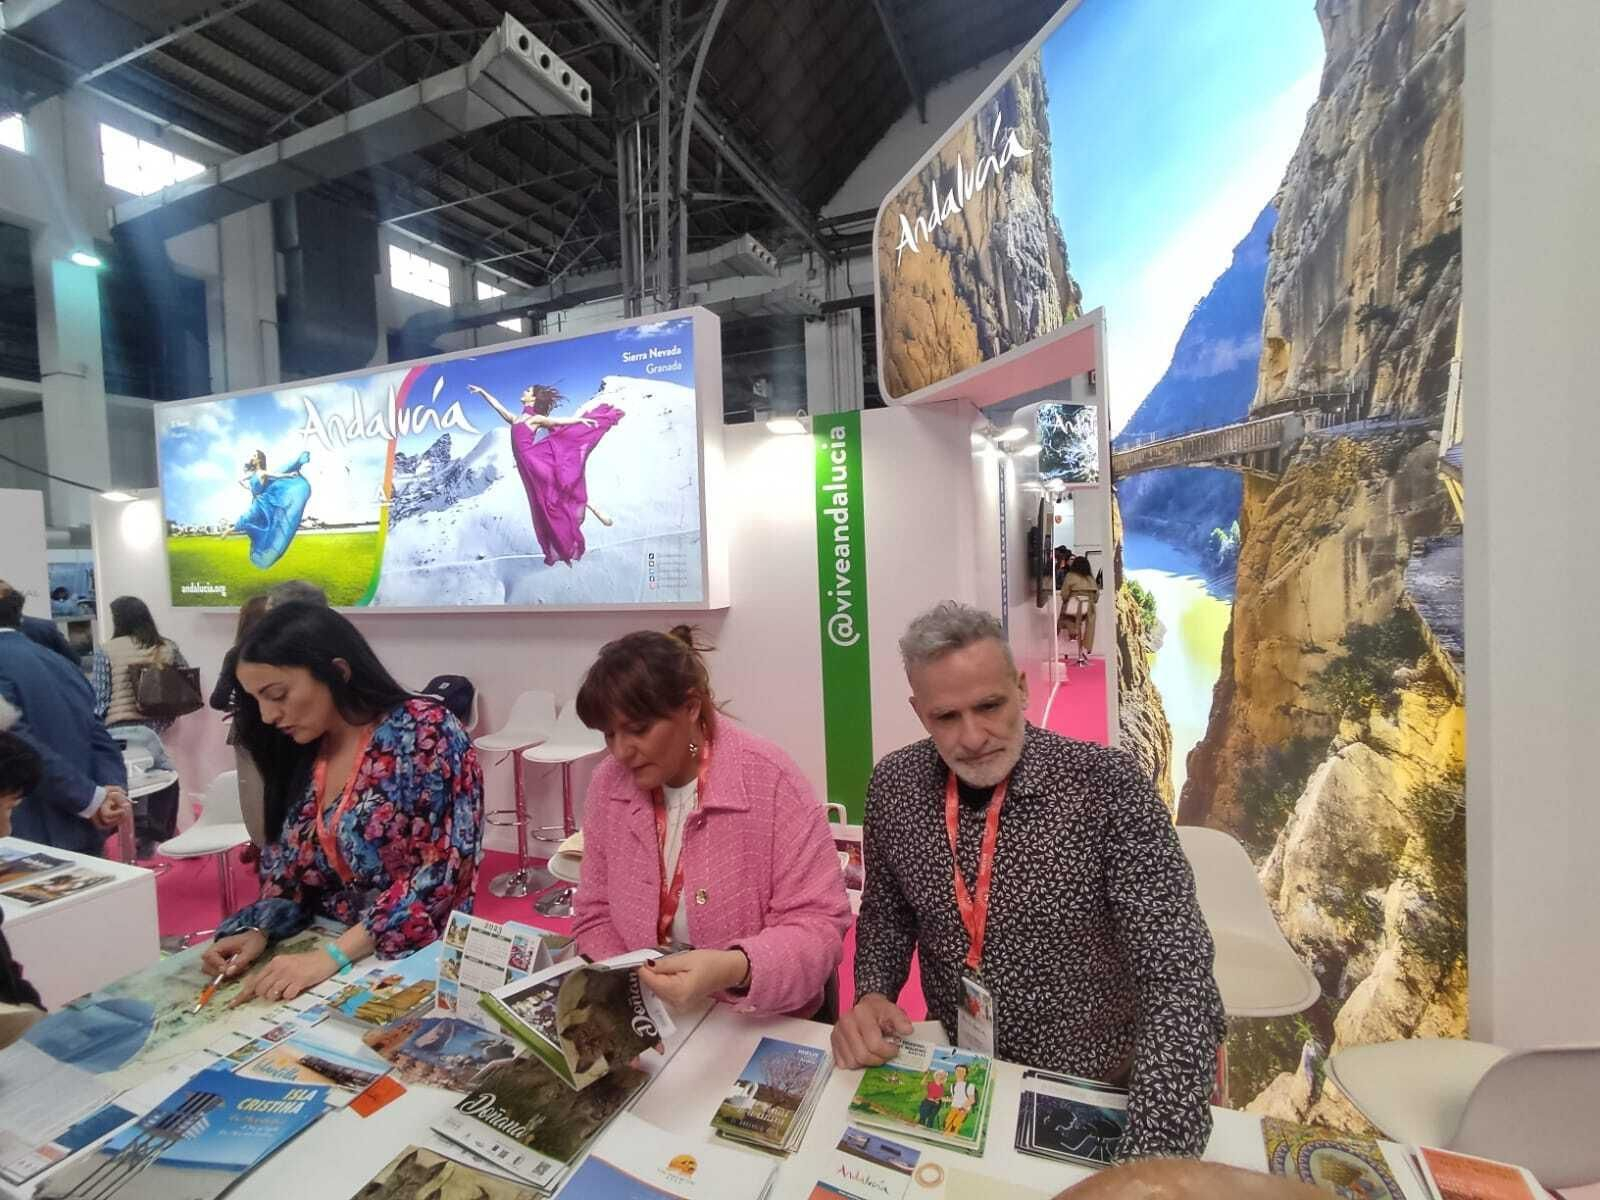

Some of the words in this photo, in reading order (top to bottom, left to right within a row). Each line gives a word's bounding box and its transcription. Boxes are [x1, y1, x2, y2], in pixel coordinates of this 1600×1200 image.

[895, 111, 1033, 266] Andalucía
[622, 352, 648, 363] Sierra
[649, 345, 682, 359] Nevada
[646, 360, 682, 374] Granada
[300, 375, 481, 450] Andalucía
[829, 424, 863, 649] @viveandalucia
[181, 582, 227, 597] andalucia.org
[629, 972, 658, 1037] Doñan
[236, 1097, 305, 1114] CRISTINA
[282, 1088, 318, 1101] ISLA
[460, 1092, 527, 1139] Doñana
